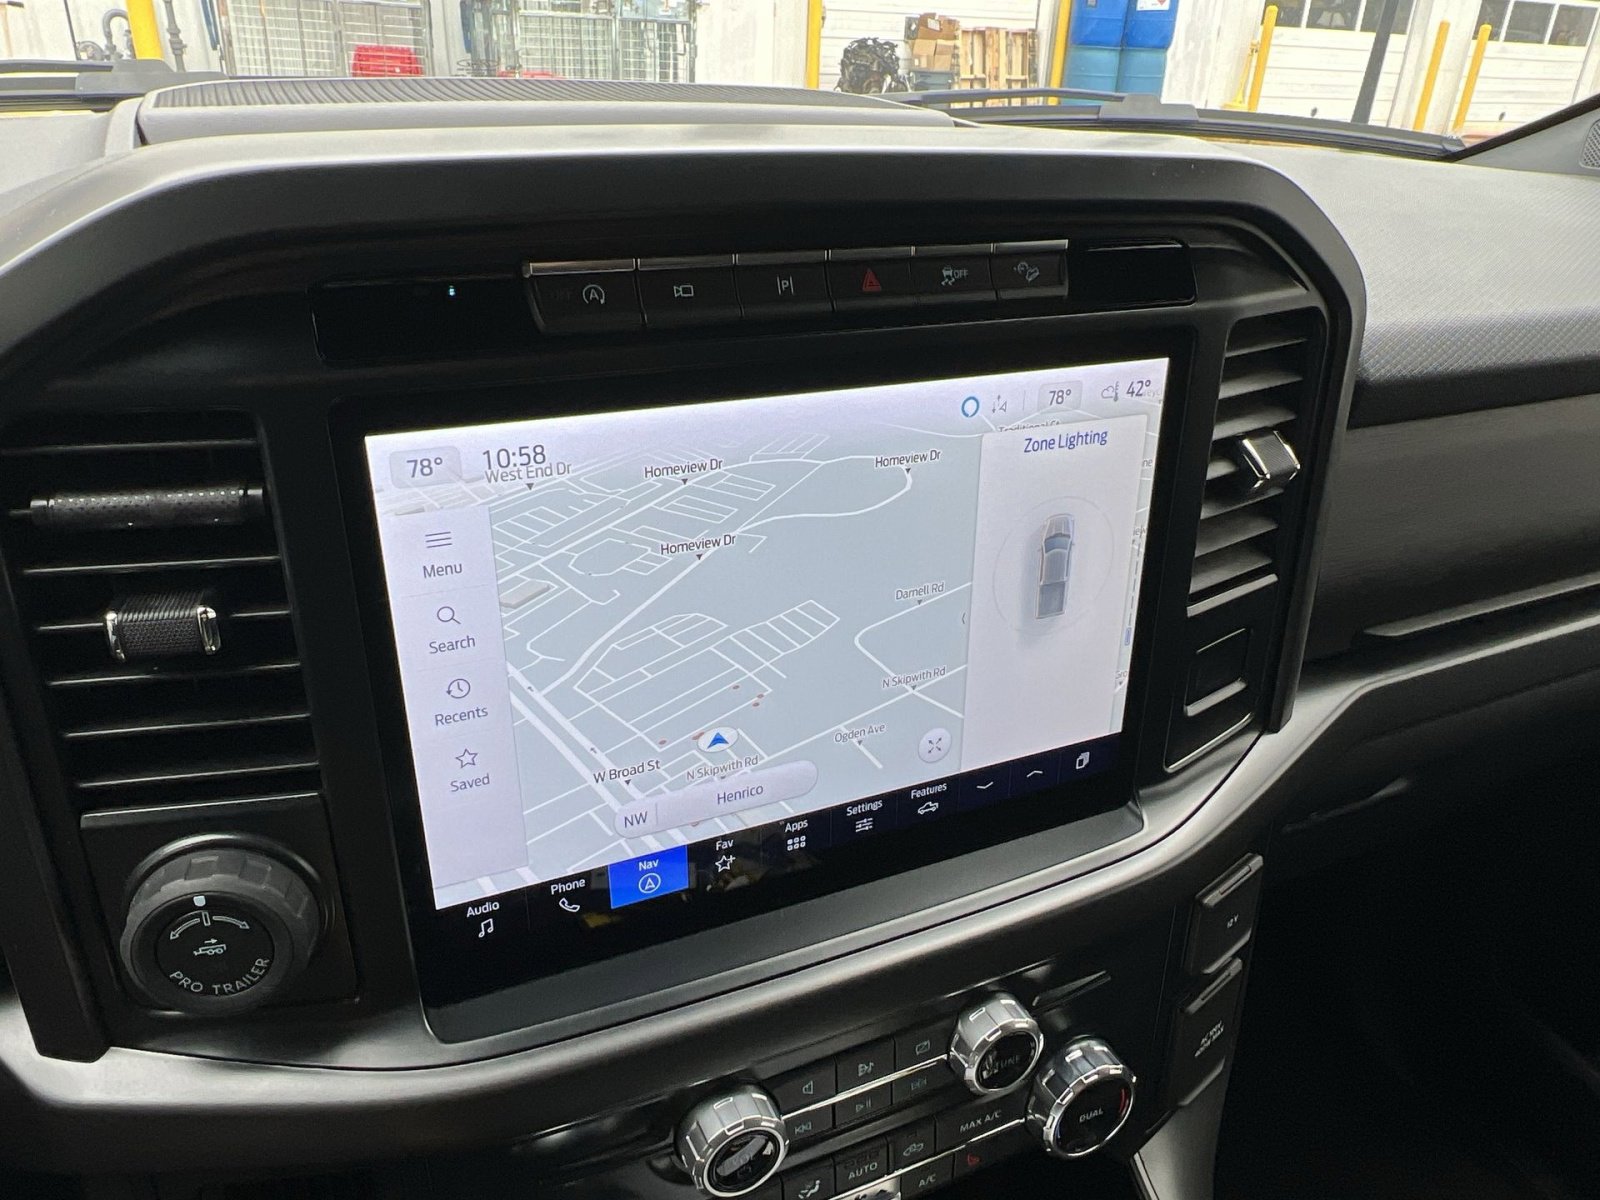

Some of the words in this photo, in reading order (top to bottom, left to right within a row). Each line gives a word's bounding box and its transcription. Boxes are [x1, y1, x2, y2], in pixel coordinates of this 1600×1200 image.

[953, 269, 968, 279] OFF
[1048, 388, 1072, 406] 78°
[1126, 379, 1151, 398] 42°
[1023, 437, 1056, 453] Zone
[1058, 430, 1108, 450] Lighting
[482, 444, 547, 470] 10:58
[875, 452, 928, 469] Homeview
[930, 449, 941, 461] Dr
[406, 456, 443, 478] 78°
[484, 467, 523, 484] West
[525, 463, 553, 480] End
[556, 461, 572, 476] Dr
[644, 461, 708, 479] Homeview
[709, 458, 724, 471] Dr
[660, 537, 721, 556] Homeview
[722, 534, 737, 546] Dr
[422, 562, 463, 578] Menu
[895, 584, 930, 600] Darnell
[931, 582, 945, 594] Rd
[429, 635, 476, 654] Search
[882, 679, 890, 689] N
[891, 669, 932, 688] Skipwith
[933, 666, 946, 678] Rd
[435, 706, 489, 727] Recents
[834, 726, 866, 743] Ogden
[867, 723, 886, 734] Ave
[593, 772, 607, 783] W
[609, 762, 645, 780] Broad
[647, 759, 661, 771] St
[686, 769, 695, 781] N
[697, 758, 742, 780] Skipwith
[744, 755, 760, 768] Rd
[450, 773, 491, 793] Saved
[911, 782, 947, 799] Features
[717, 785, 764, 805] Henrico
[846, 799, 883, 816] Settings
[623, 811, 648, 828] NW
[784, 818, 808, 833] Apps
[715, 838, 734, 851] Fav
[638, 858, 659, 871] Nav
[550, 878, 586, 895] Phone
[466, 900, 500, 918] Audio
[169, 970, 204, 992] PRO
[212, 957, 270, 995] TRAILER
[959, 1117, 982, 1134] MAX
[984, 1109, 1003, 1122] A/C
[1079, 1107, 1104, 1123] DUAL
[848, 1161, 878, 1180] AUTO
[918, 1173, 937, 1188] A/C
